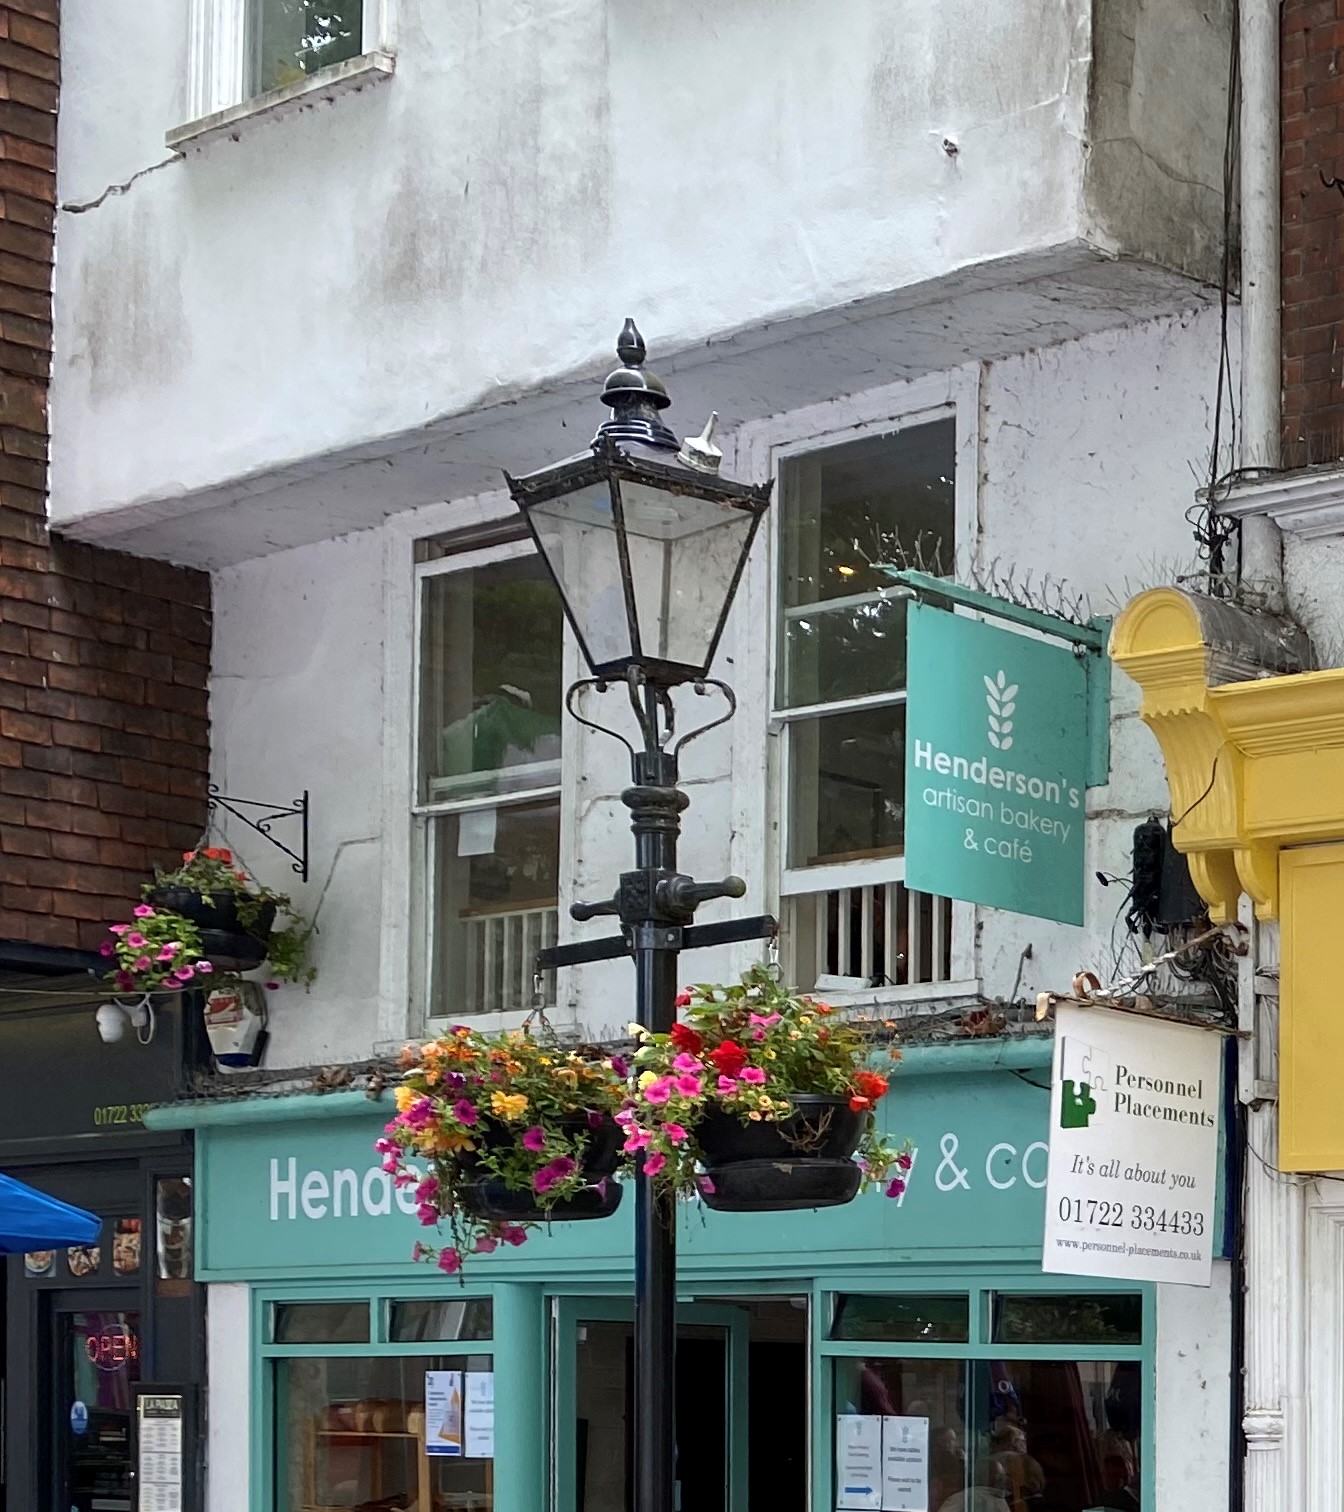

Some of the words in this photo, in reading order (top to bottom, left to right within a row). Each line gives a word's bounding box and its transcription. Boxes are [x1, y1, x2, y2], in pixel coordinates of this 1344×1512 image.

[915, 739, 1079, 808] Henderson's
[923, 787, 992, 821] artisan
[1001, 803, 1070, 844] bakery
[964, 829, 978, 850] &
[984, 835, 1032, 862] café
[1116, 1065, 1203, 1099] Personnel
[94, 1106, 127, 1125] 01722
[1115, 1092, 1215, 1128] Placements
[935, 1133, 970, 1192] &
[1070, 1154, 1094, 1175] It's
[1100, 1159, 1120, 1178] all
[1124, 1163, 1166, 1185] about
[1169, 1173, 1196, 1190] you
[1059, 1197, 1123, 1227] 01722
[1131, 1205, 1204, 1236] 334433
[1056, 1238, 1201, 1261] www.personnel-placements.co.uk
[85, 1335, 138, 1362] OPEN
